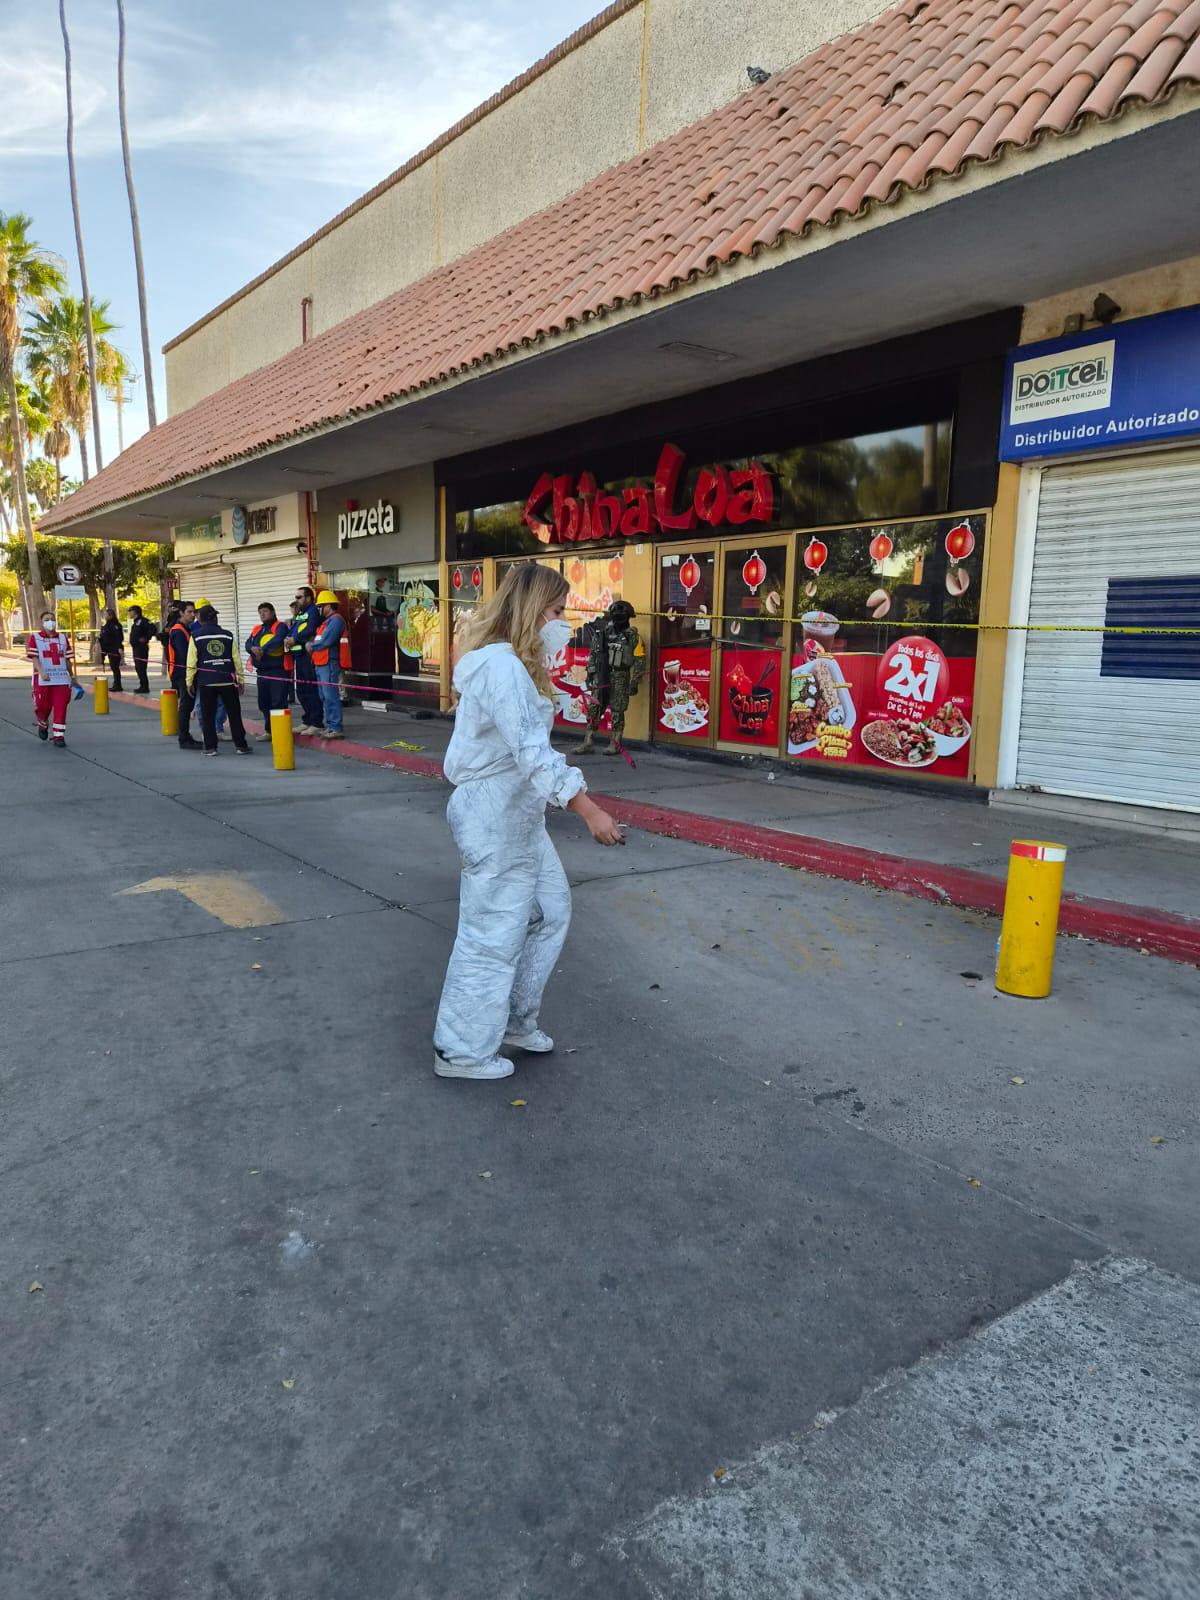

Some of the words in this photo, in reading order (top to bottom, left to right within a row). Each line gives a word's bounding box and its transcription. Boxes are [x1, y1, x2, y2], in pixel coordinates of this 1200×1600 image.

[1014, 398, 1060, 411] DISTRIBUIDOR
[1062, 388, 1107, 402] AUTORIZADO
[1015, 424, 1102, 447] Distribuidor
[1106, 407, 1200, 434] Autorizado
[523, 471, 649, 544] China
[652, 442, 773, 533] Loa
[338, 498, 394, 549] pizzeta
[897, 643, 914, 656] Todos
[914, 646, 924, 659] los
[925, 649, 940, 662] días
[884, 653, 941, 703] 2x1
[732, 694, 769, 713] China
[887, 700, 896, 711] De
[897, 704, 902, 713] 6
[909, 707, 913, 716] 7
[740, 712, 763, 730] Loa
[816, 721, 852, 739] Combo
